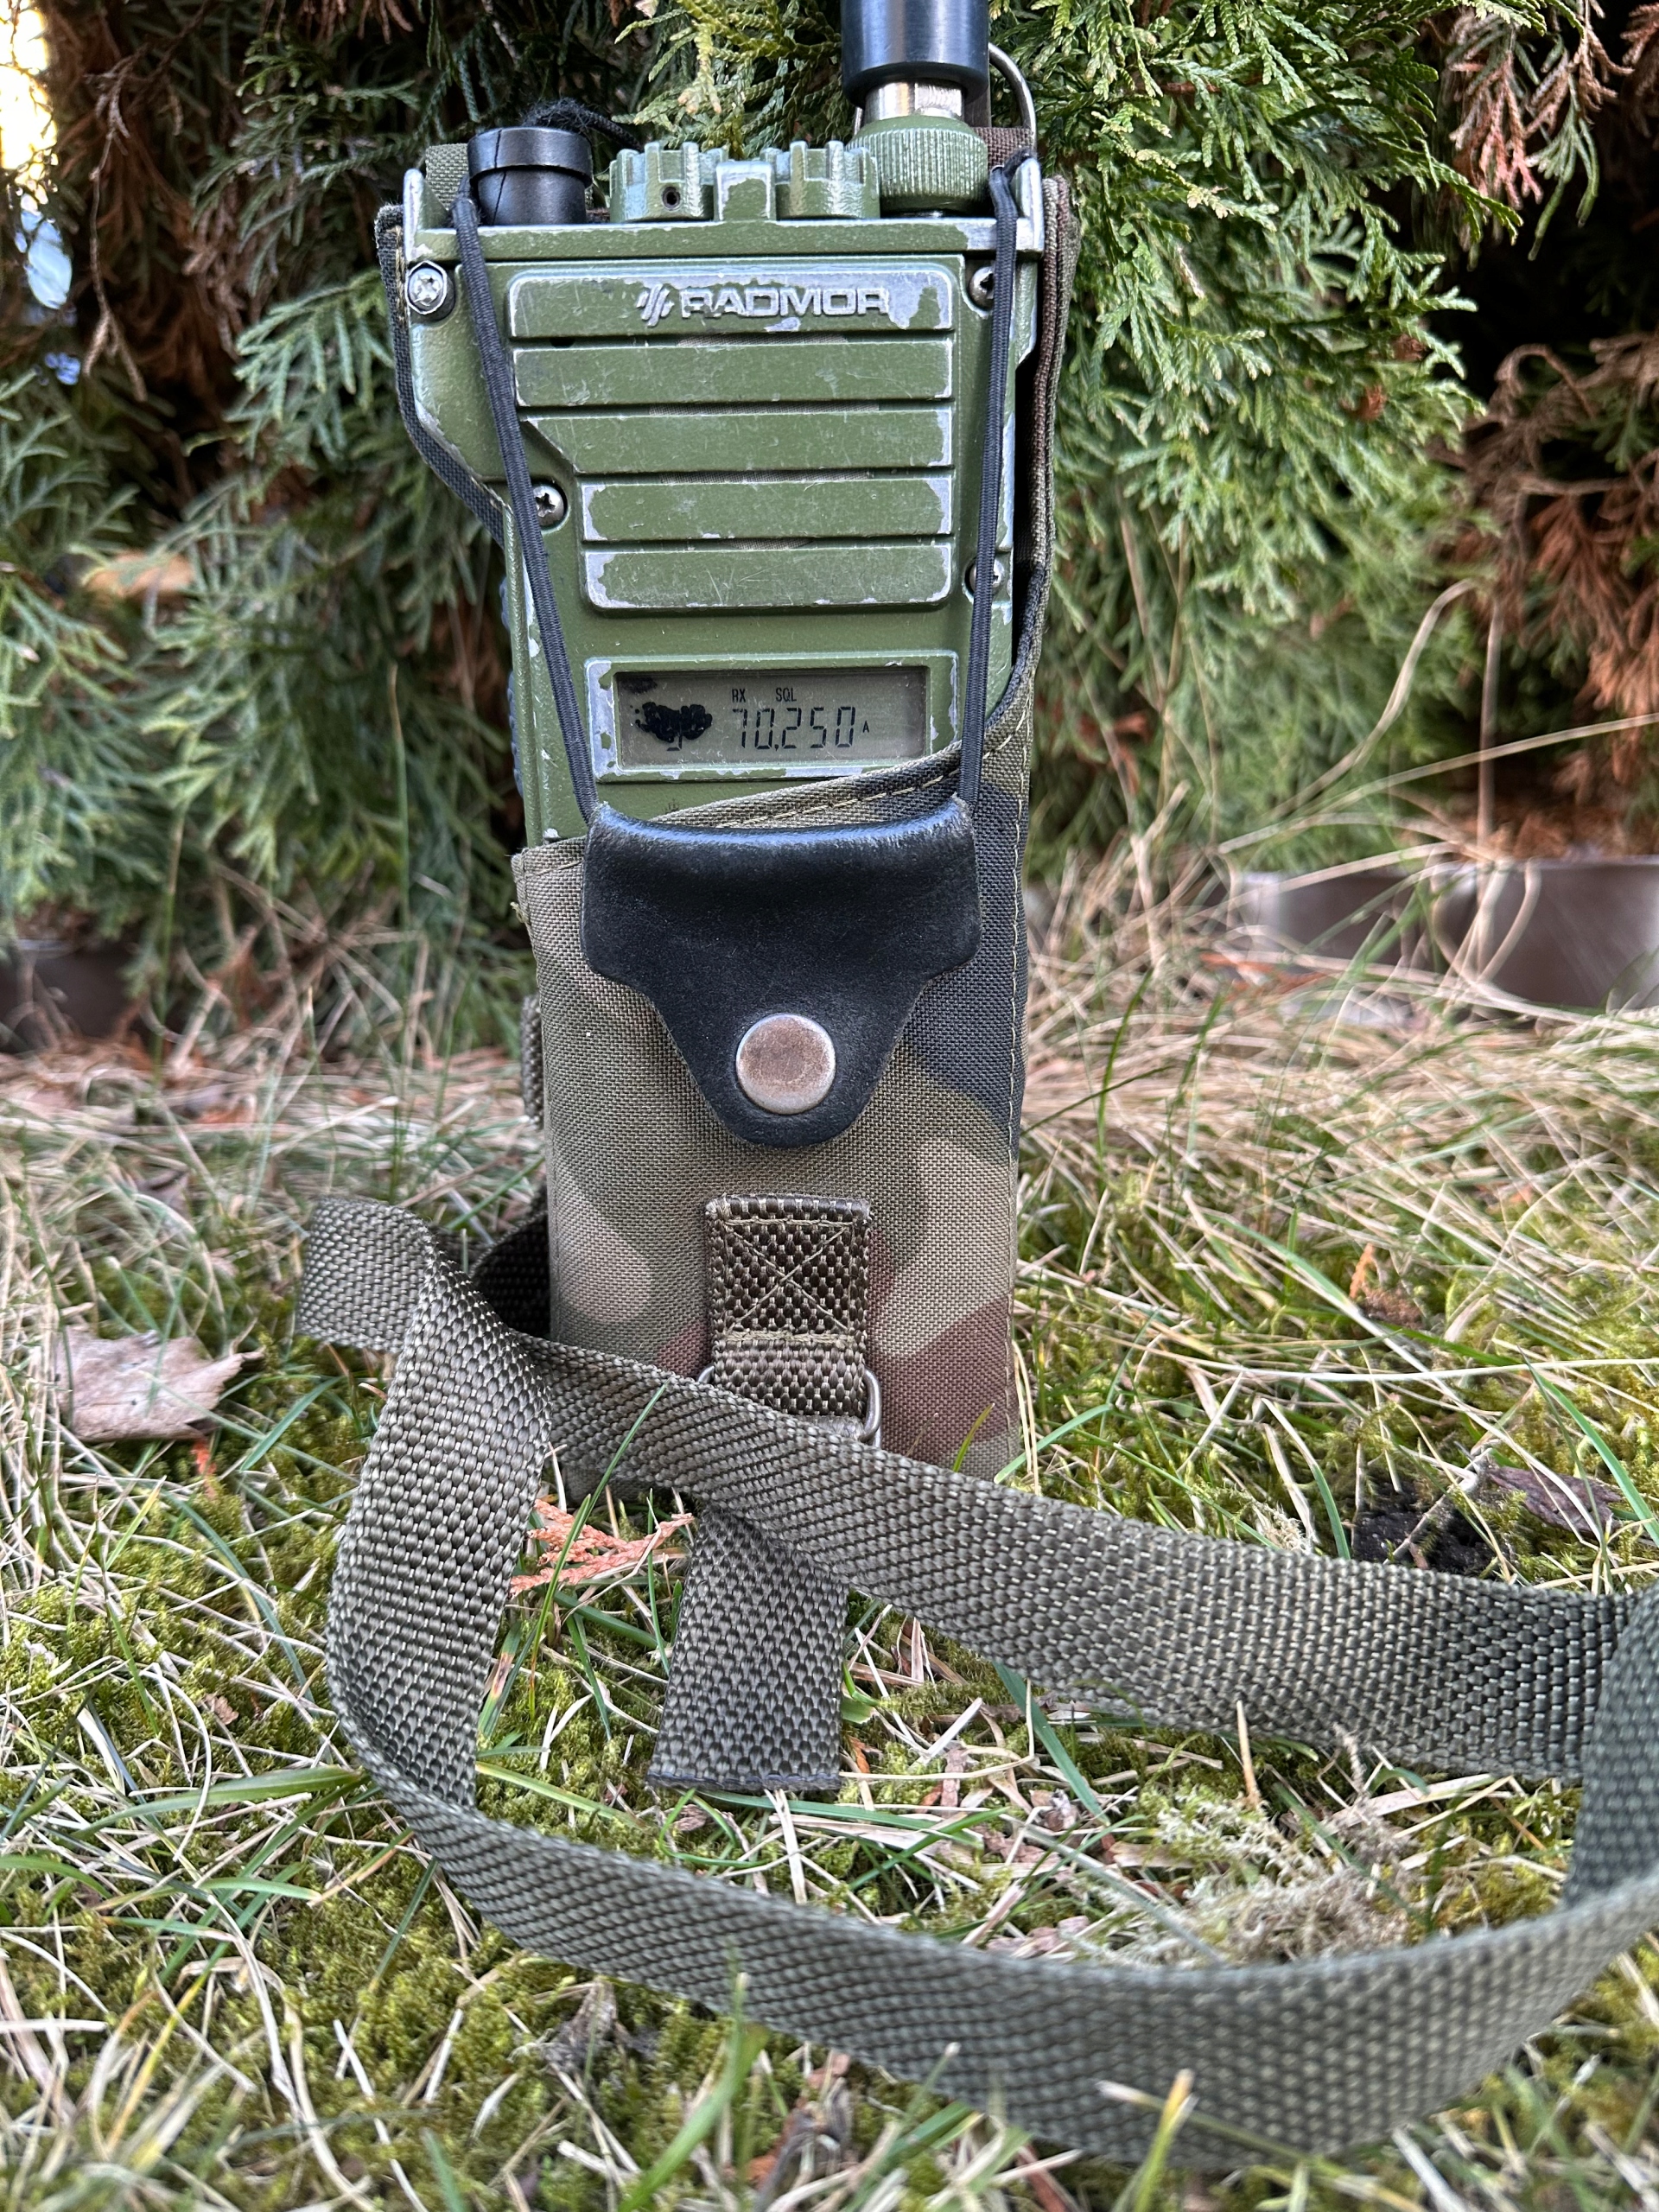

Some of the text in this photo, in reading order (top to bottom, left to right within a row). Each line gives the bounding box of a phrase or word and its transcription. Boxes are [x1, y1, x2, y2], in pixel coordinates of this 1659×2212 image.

[680, 286, 890, 319] RADMOR
[732, 687, 798, 702] RX SQL
